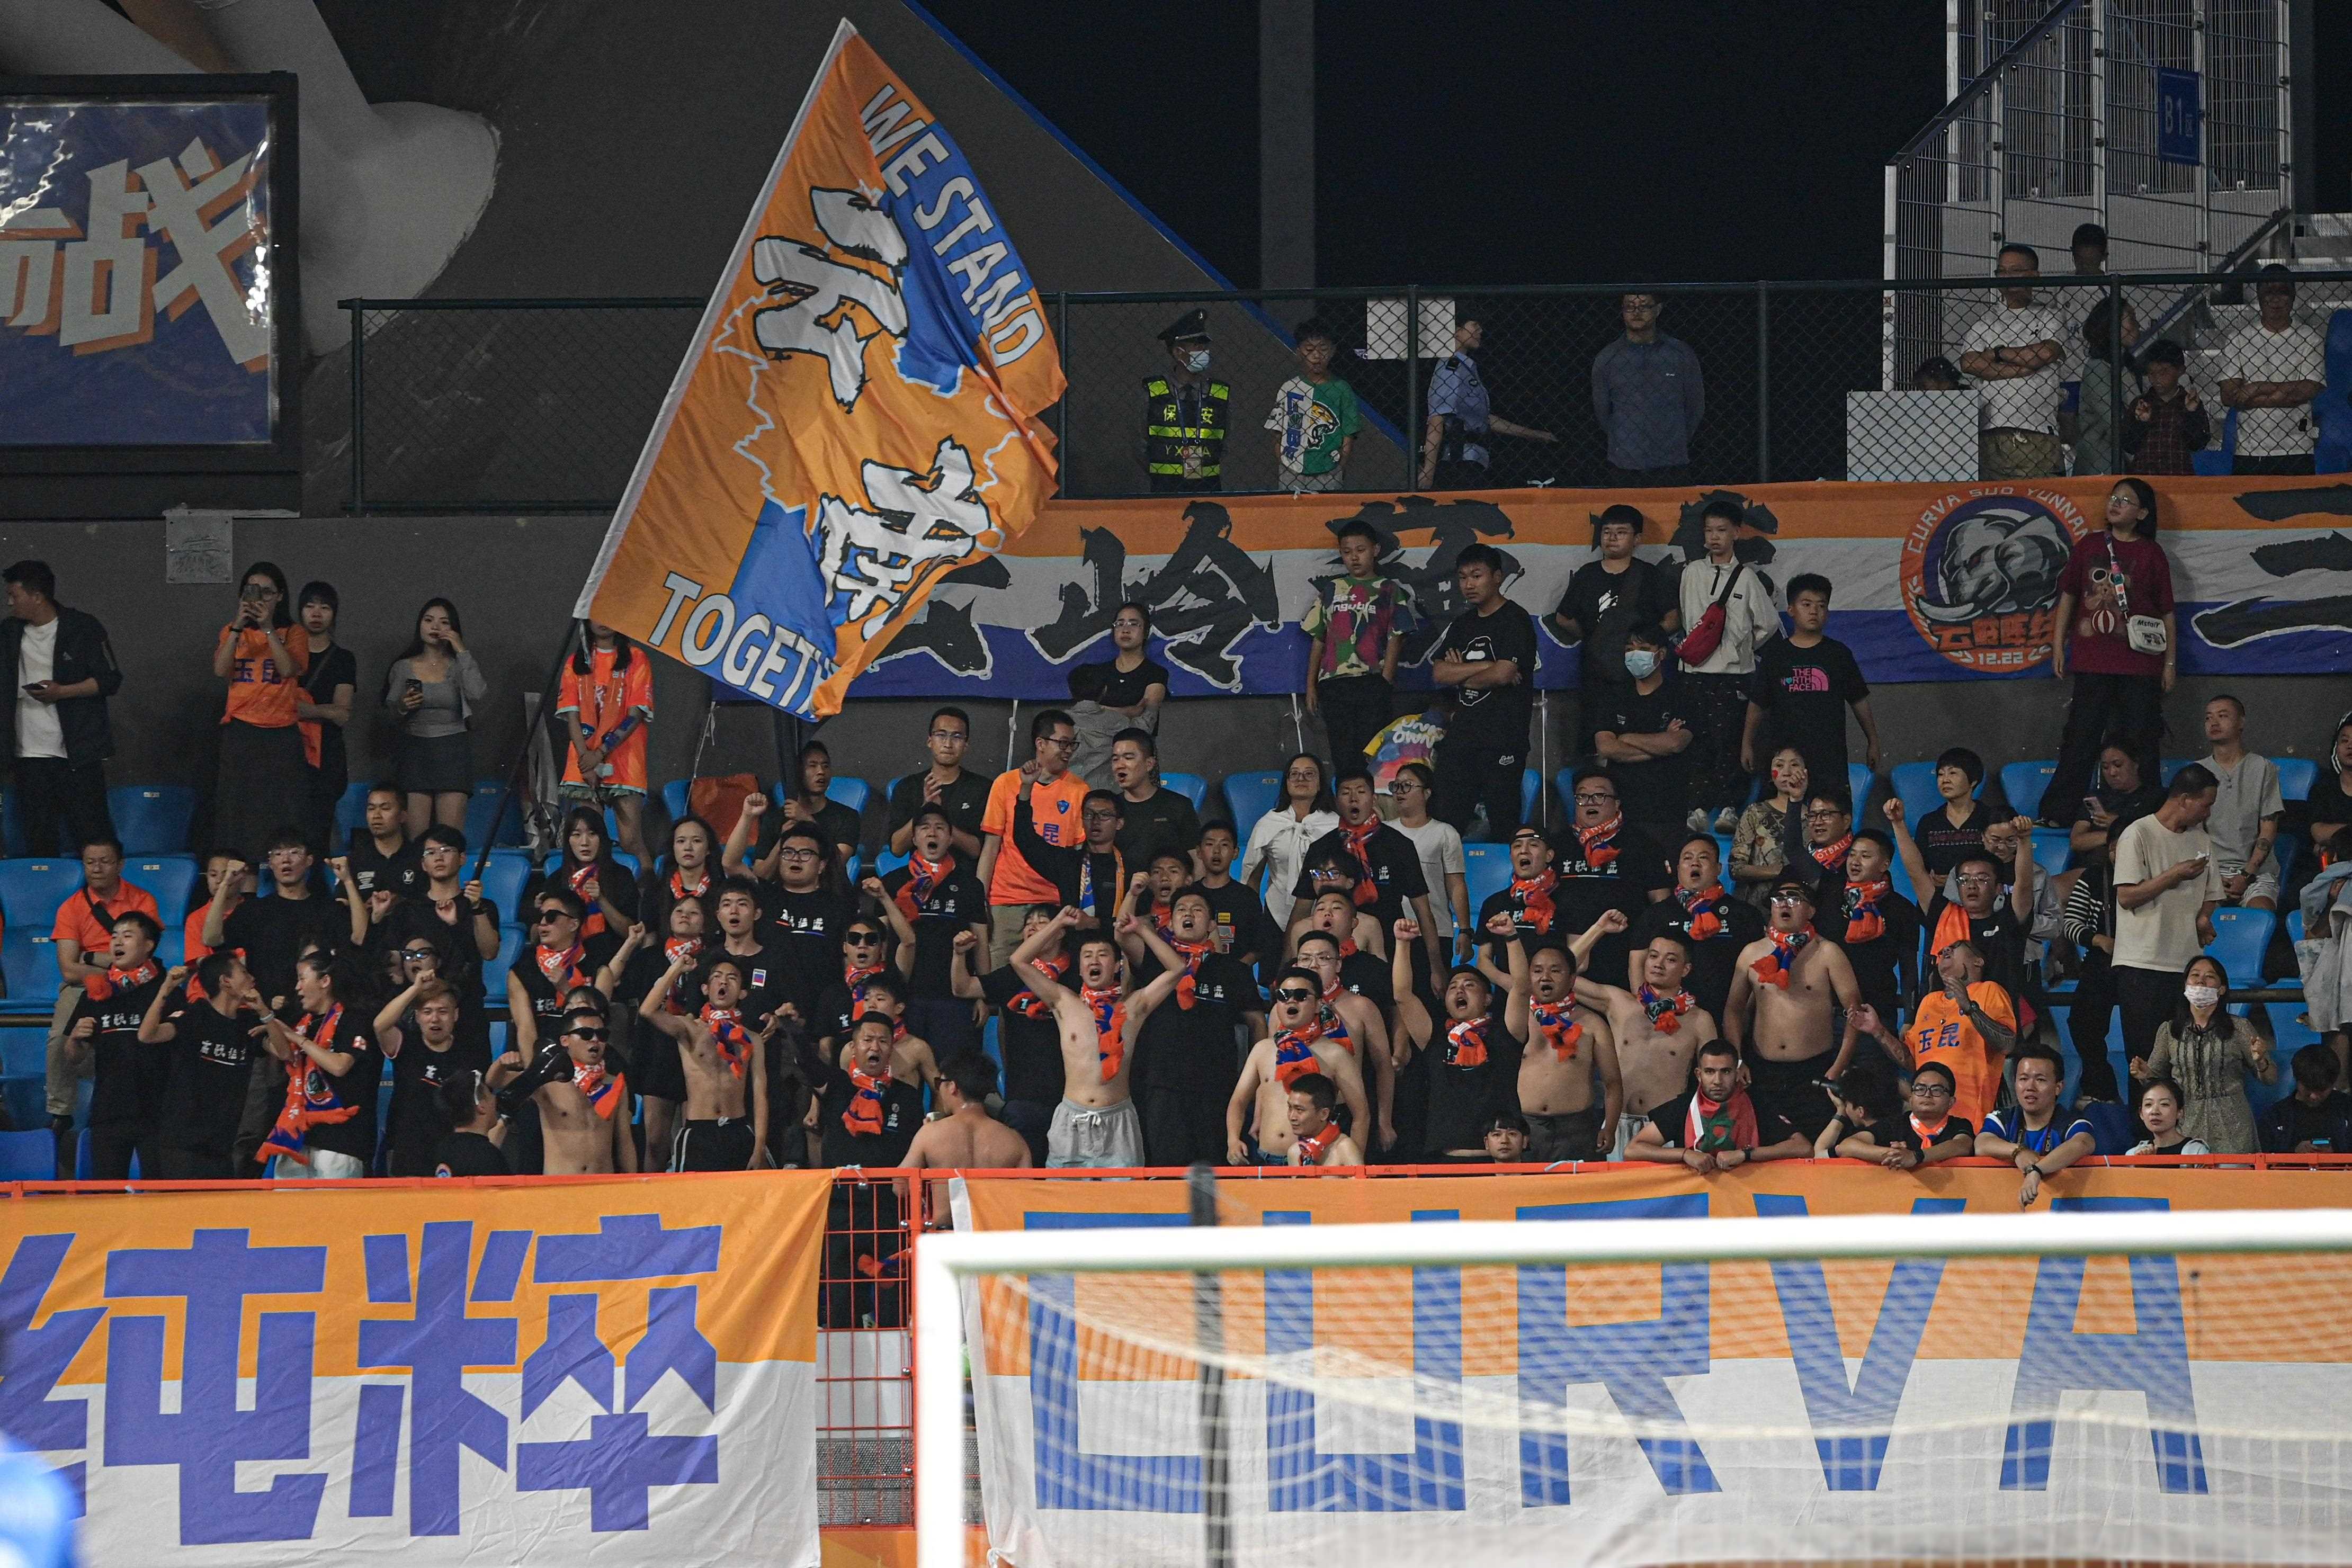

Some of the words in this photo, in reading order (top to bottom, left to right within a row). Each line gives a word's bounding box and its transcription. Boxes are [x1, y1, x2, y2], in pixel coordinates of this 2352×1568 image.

[858, 84, 948, 198] WE
[913, 174, 1044, 366] STAND
[1163, 404, 1214, 424] 保安
[1908, 494, 1961, 553] CURVA
[1792, 668, 1811, 676] THE
[1979, 651, 2024, 665] 12.22
[1788, 684, 1811, 692] FACE
[1919, 1023, 1960, 1053] 玉昆
[1023, 1193, 2210, 1515] CURVA
[0, 1213, 722, 1545] 纯粹
